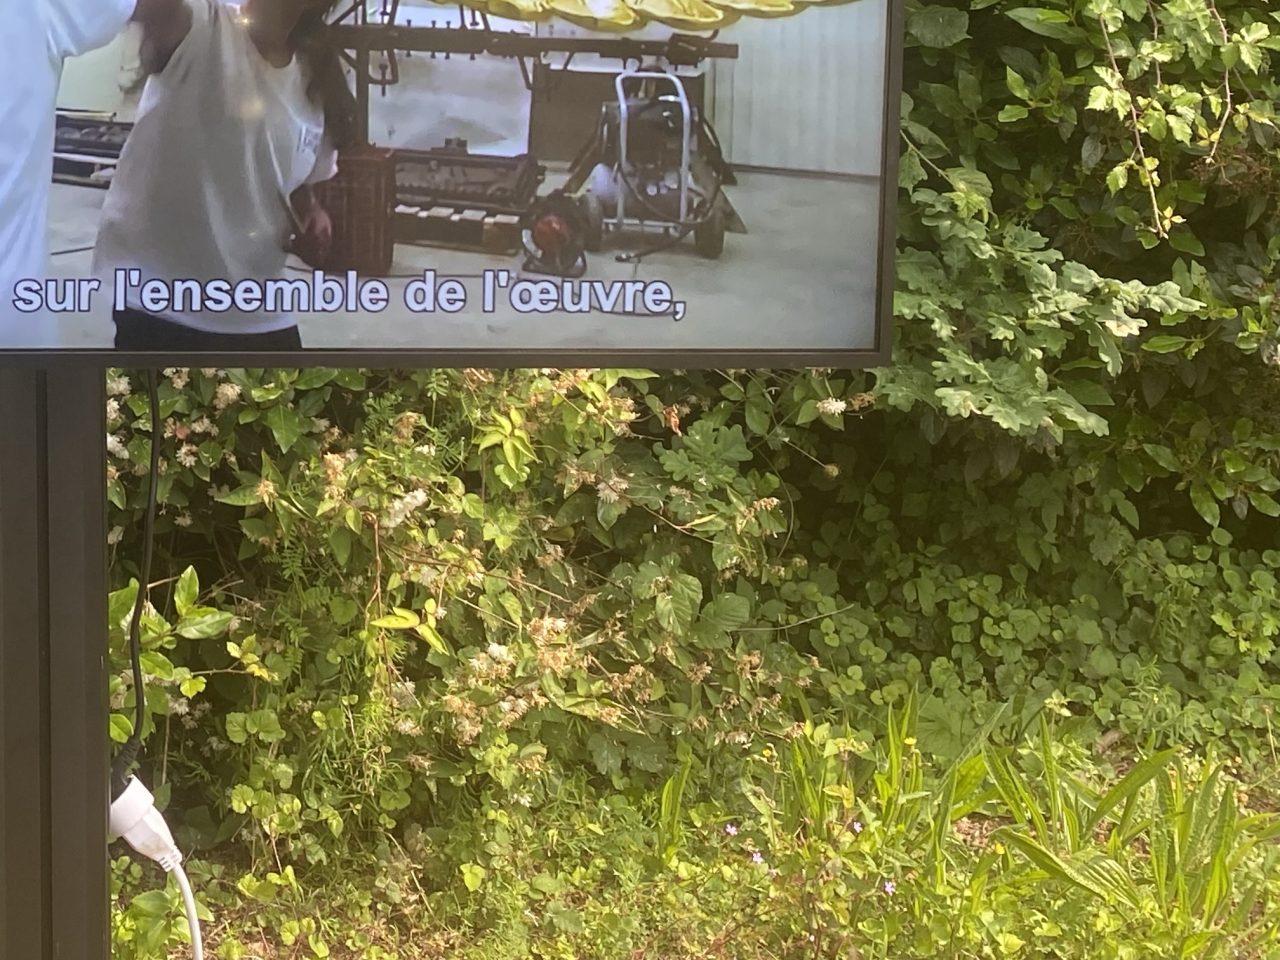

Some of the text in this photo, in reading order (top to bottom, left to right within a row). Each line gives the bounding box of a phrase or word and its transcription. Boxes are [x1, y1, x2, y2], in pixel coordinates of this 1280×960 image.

[12, 277, 100, 314] sur
[114, 269, 389, 313] l'ensemble
[404, 269, 465, 313] de
[482, 269, 686, 321] l'œuvre,
